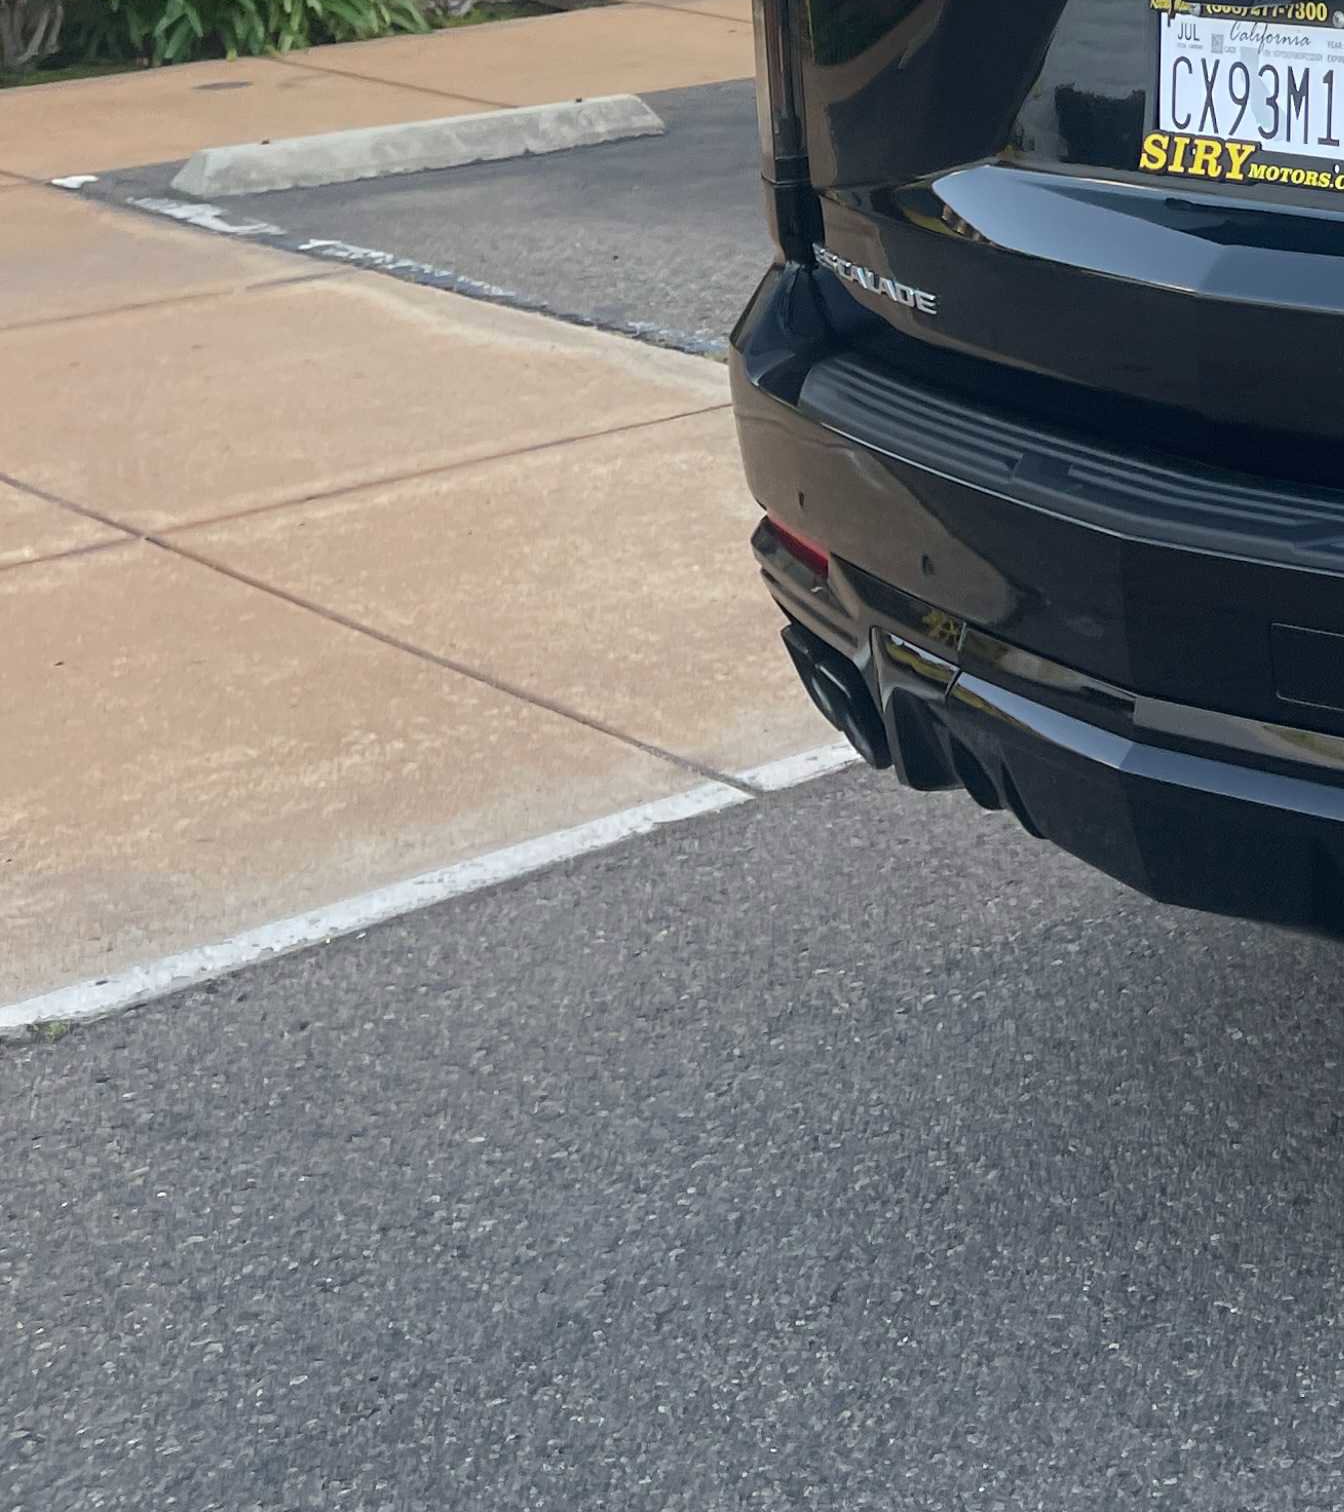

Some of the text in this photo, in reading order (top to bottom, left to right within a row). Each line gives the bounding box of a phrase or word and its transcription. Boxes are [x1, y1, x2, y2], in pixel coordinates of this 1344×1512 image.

[1177, 21, 1312, 55] JUL California
[811, 242, 938, 315] ESCALADE
